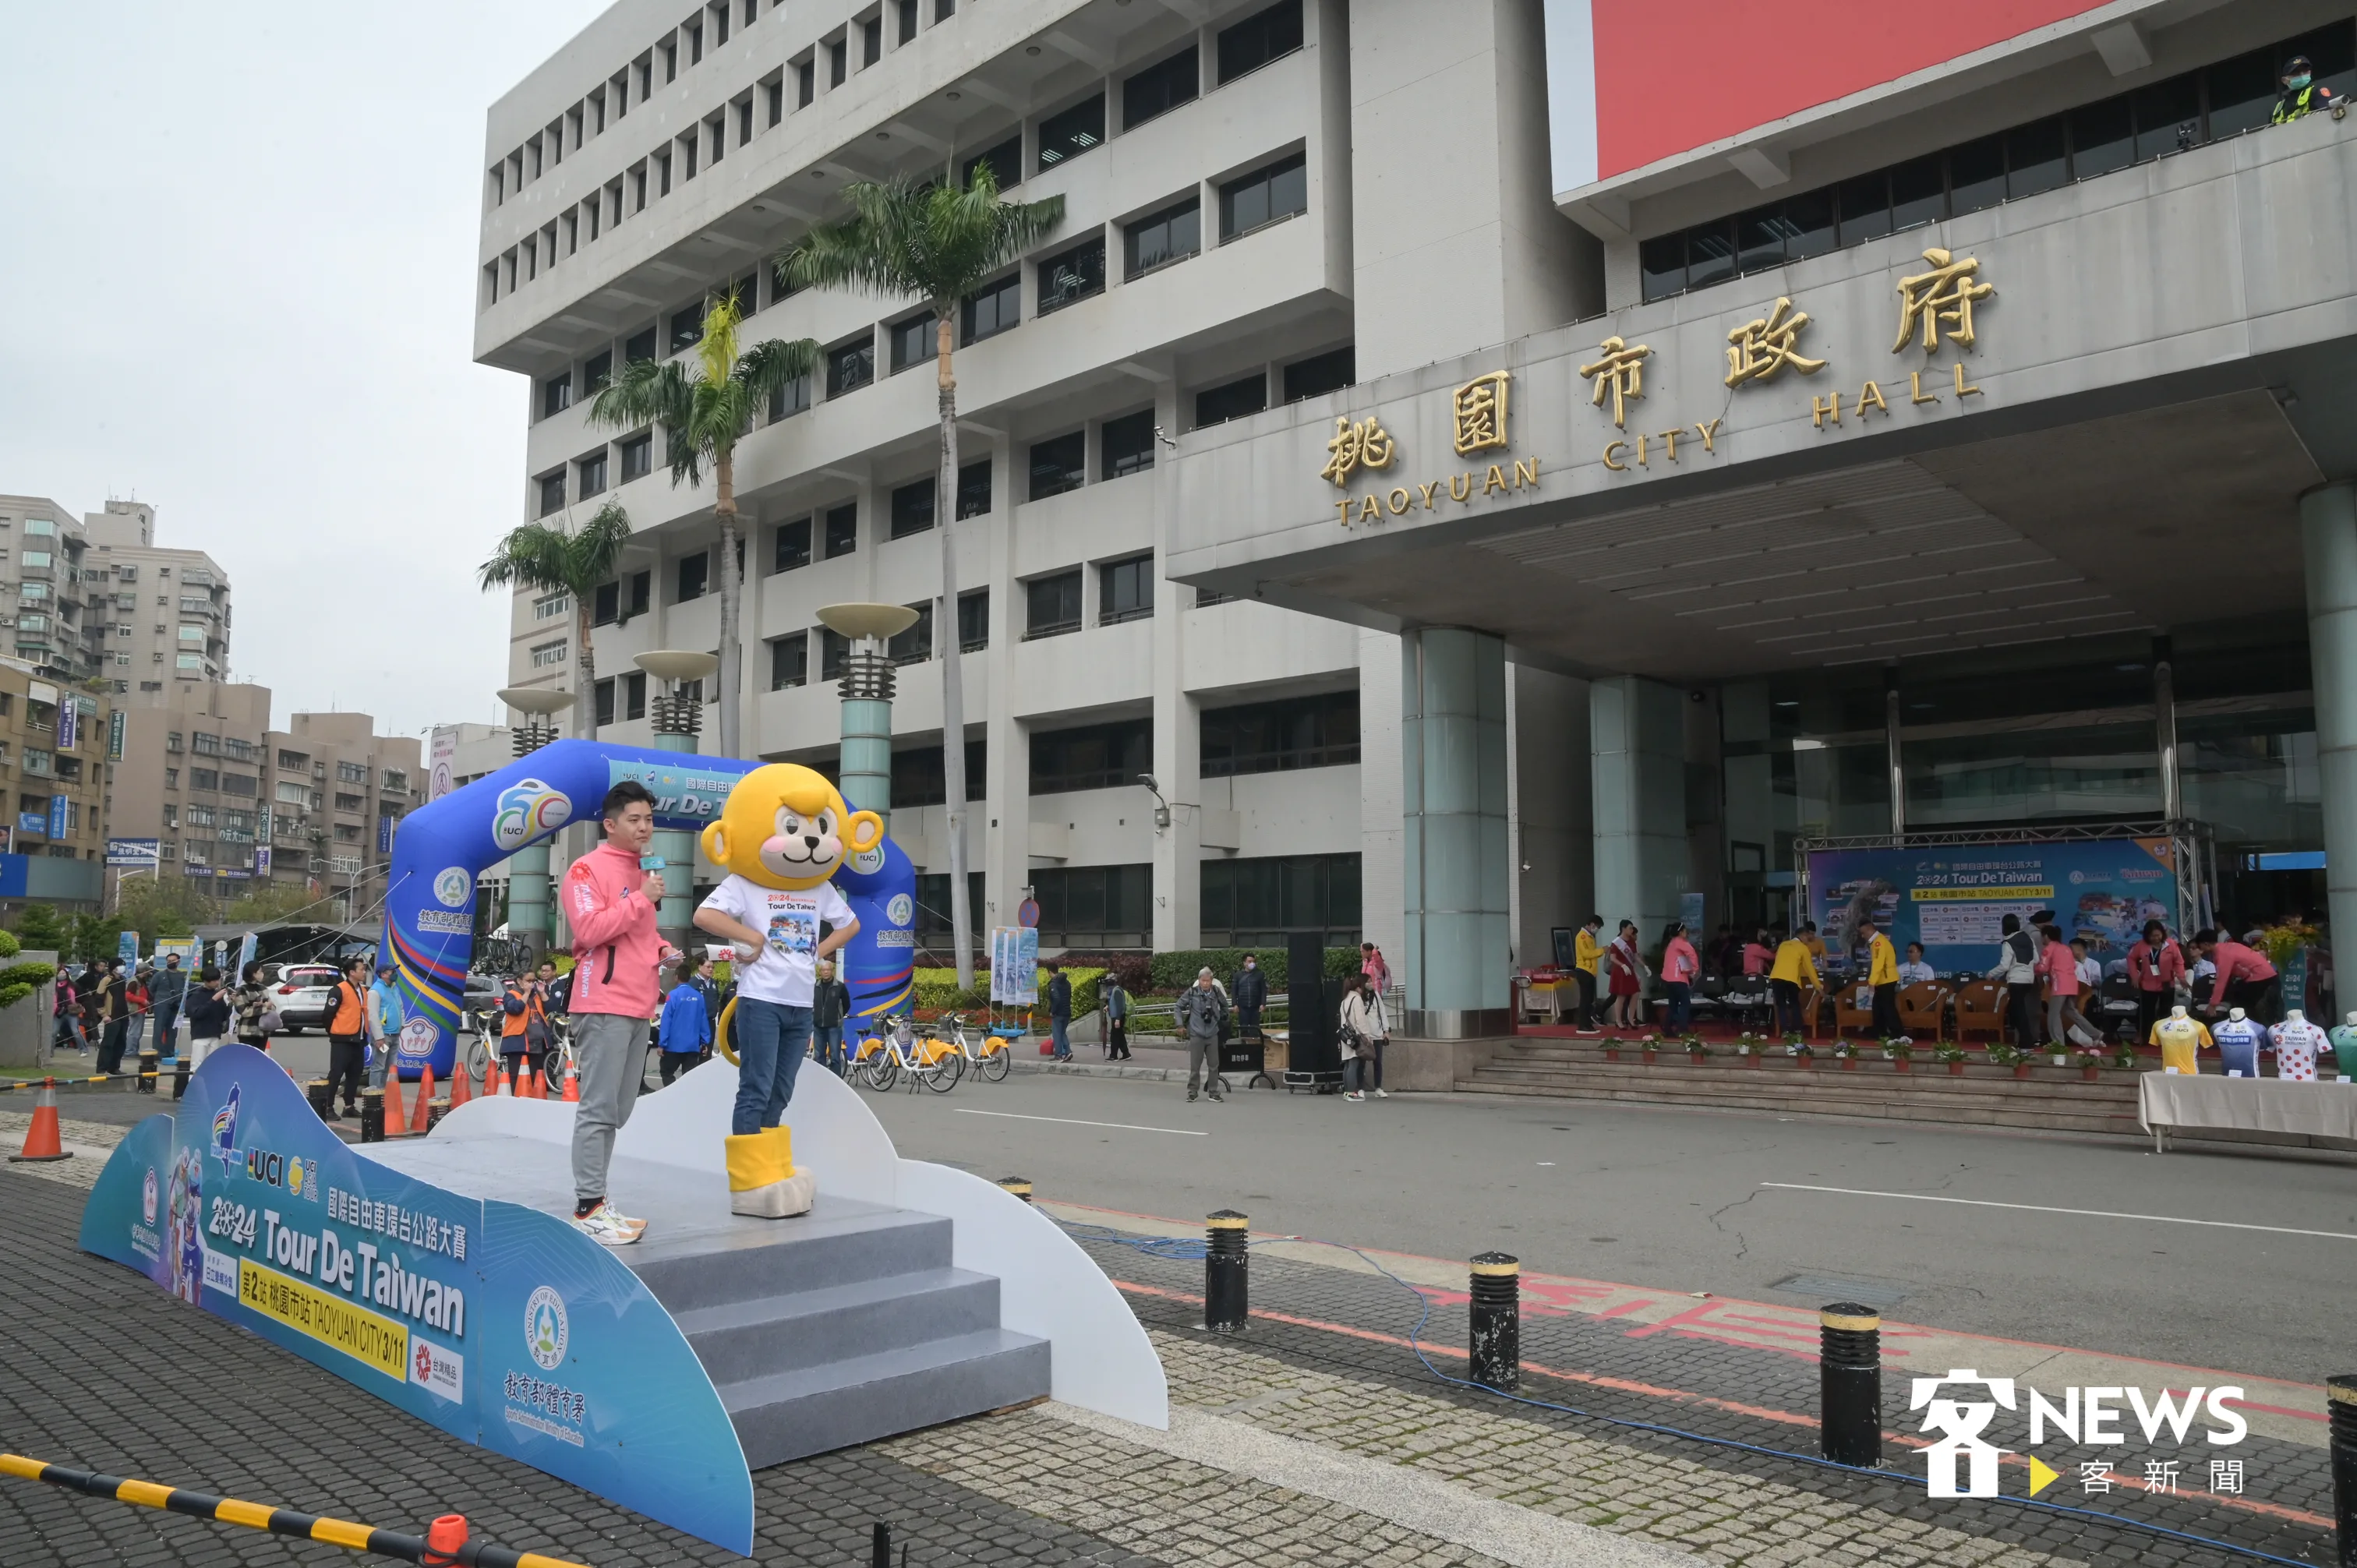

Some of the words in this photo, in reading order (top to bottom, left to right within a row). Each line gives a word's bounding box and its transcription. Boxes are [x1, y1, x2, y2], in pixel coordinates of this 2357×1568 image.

[1320, 248, 1995, 488] 桃園市政府
[1334, 456, 1539, 527] TAOYUAN
[1603, 418, 1719, 471] CITY
[1812, 362, 1980, 429] HALL
[653, 796, 677, 812] ur
[677, 794, 712, 816] De
[1916, 874, 1949, 885] 2024
[1951, 873, 1979, 885] Tour
[1981, 872, 1998, 884] De
[1999, 871, 2043, 883] Taiwan
[254, 1148, 284, 1188] UCI
[305, 1173, 317, 1188] ASIA
[306, 1159, 316, 1173] UCI
[304, 1187, 318, 1202] TOUR
[327, 1187, 466, 1261] 國際自由車環台公路大賽
[209, 1196, 258, 1248] 2024
[264, 1209, 317, 1275] Tour
[320, 1228, 354, 1292] De
[358, 1241, 464, 1337] Taiwan
[242, 1270, 267, 1305] 第2站
[269, 1280, 311, 1325] 桃園市站
[313, 1299, 357, 1348] TAOYUAN
[359, 1319, 383, 1359] CITY
[383, 1331, 405, 1368] 3/11
[528, 1295, 539, 1344] MINISTRY
[540, 1291, 548, 1301] OF
[549, 1294, 565, 1354] EDUCATION
[533, 1346, 558, 1365] 教育部
[504, 1369, 585, 1425] 教育部體育署
